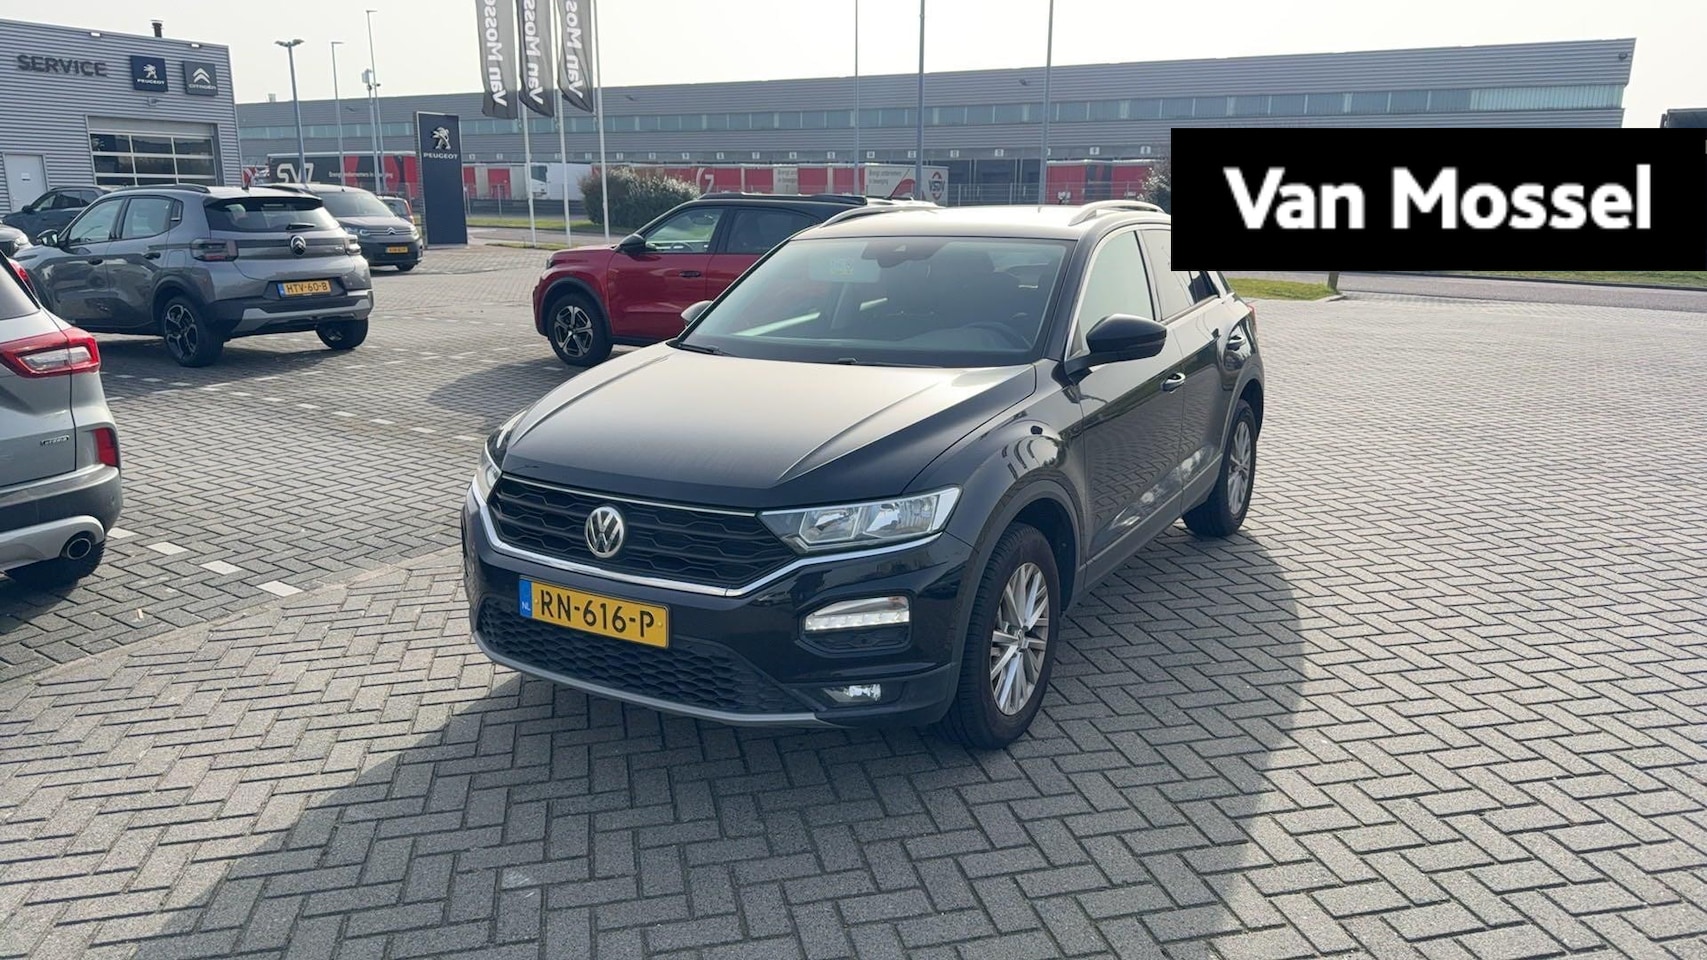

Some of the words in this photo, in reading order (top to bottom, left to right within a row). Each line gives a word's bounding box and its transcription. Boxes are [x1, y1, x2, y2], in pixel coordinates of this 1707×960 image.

[17, 54, 107, 78] SERVICE
[423, 152, 458, 160] PEUGEOT
[286, 281, 328, 294] HTV-60-B
[521, 601, 531, 611] NL
[540, 589, 654, 638] RN-616-P
